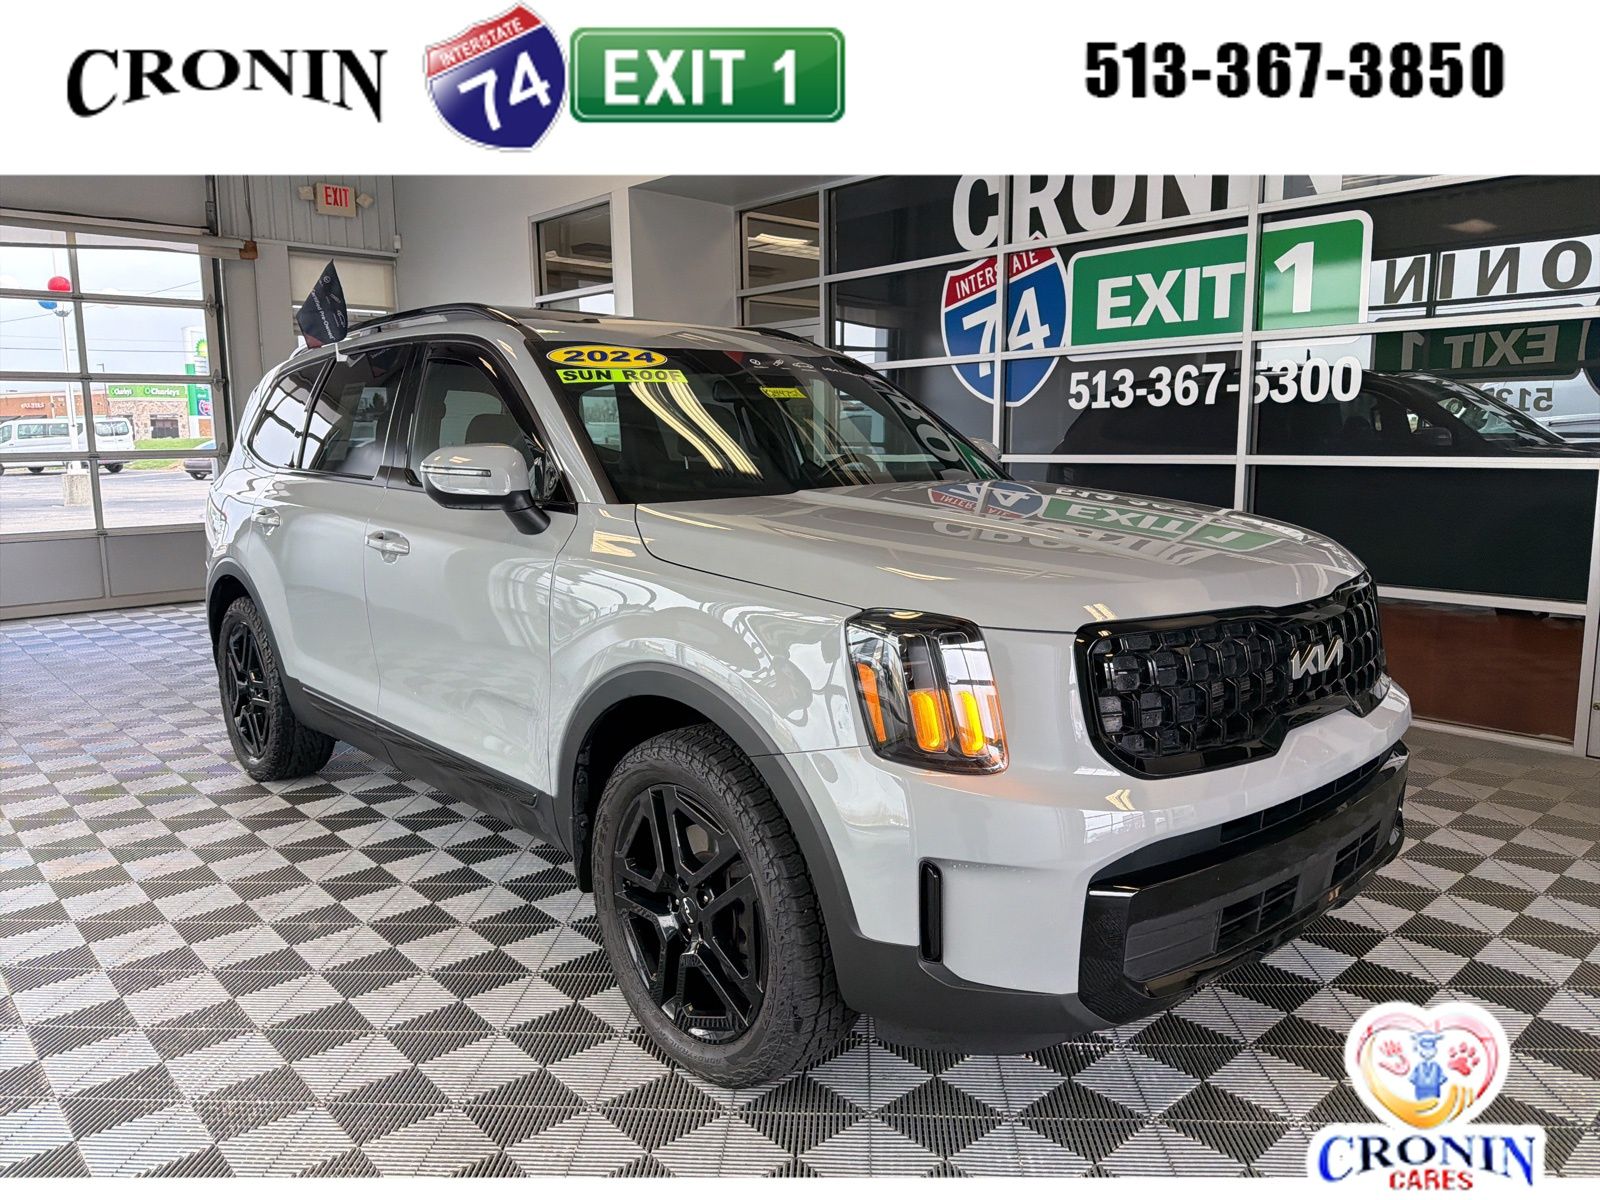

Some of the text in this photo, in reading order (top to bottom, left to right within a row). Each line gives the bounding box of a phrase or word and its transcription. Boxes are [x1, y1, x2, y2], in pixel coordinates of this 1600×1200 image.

[323, 185, 350, 208] EXIT
[952, 174, 1342, 252] CRON
[955, 250, 1039, 300] INTERATE
[1096, 240, 1316, 330] EXIT 1
[961, 286, 1051, 378] 74
[562, 369, 681, 381] SUN ROOF
[563, 350, 656, 364] 2024
[1289, 634, 1344, 680] KIA
